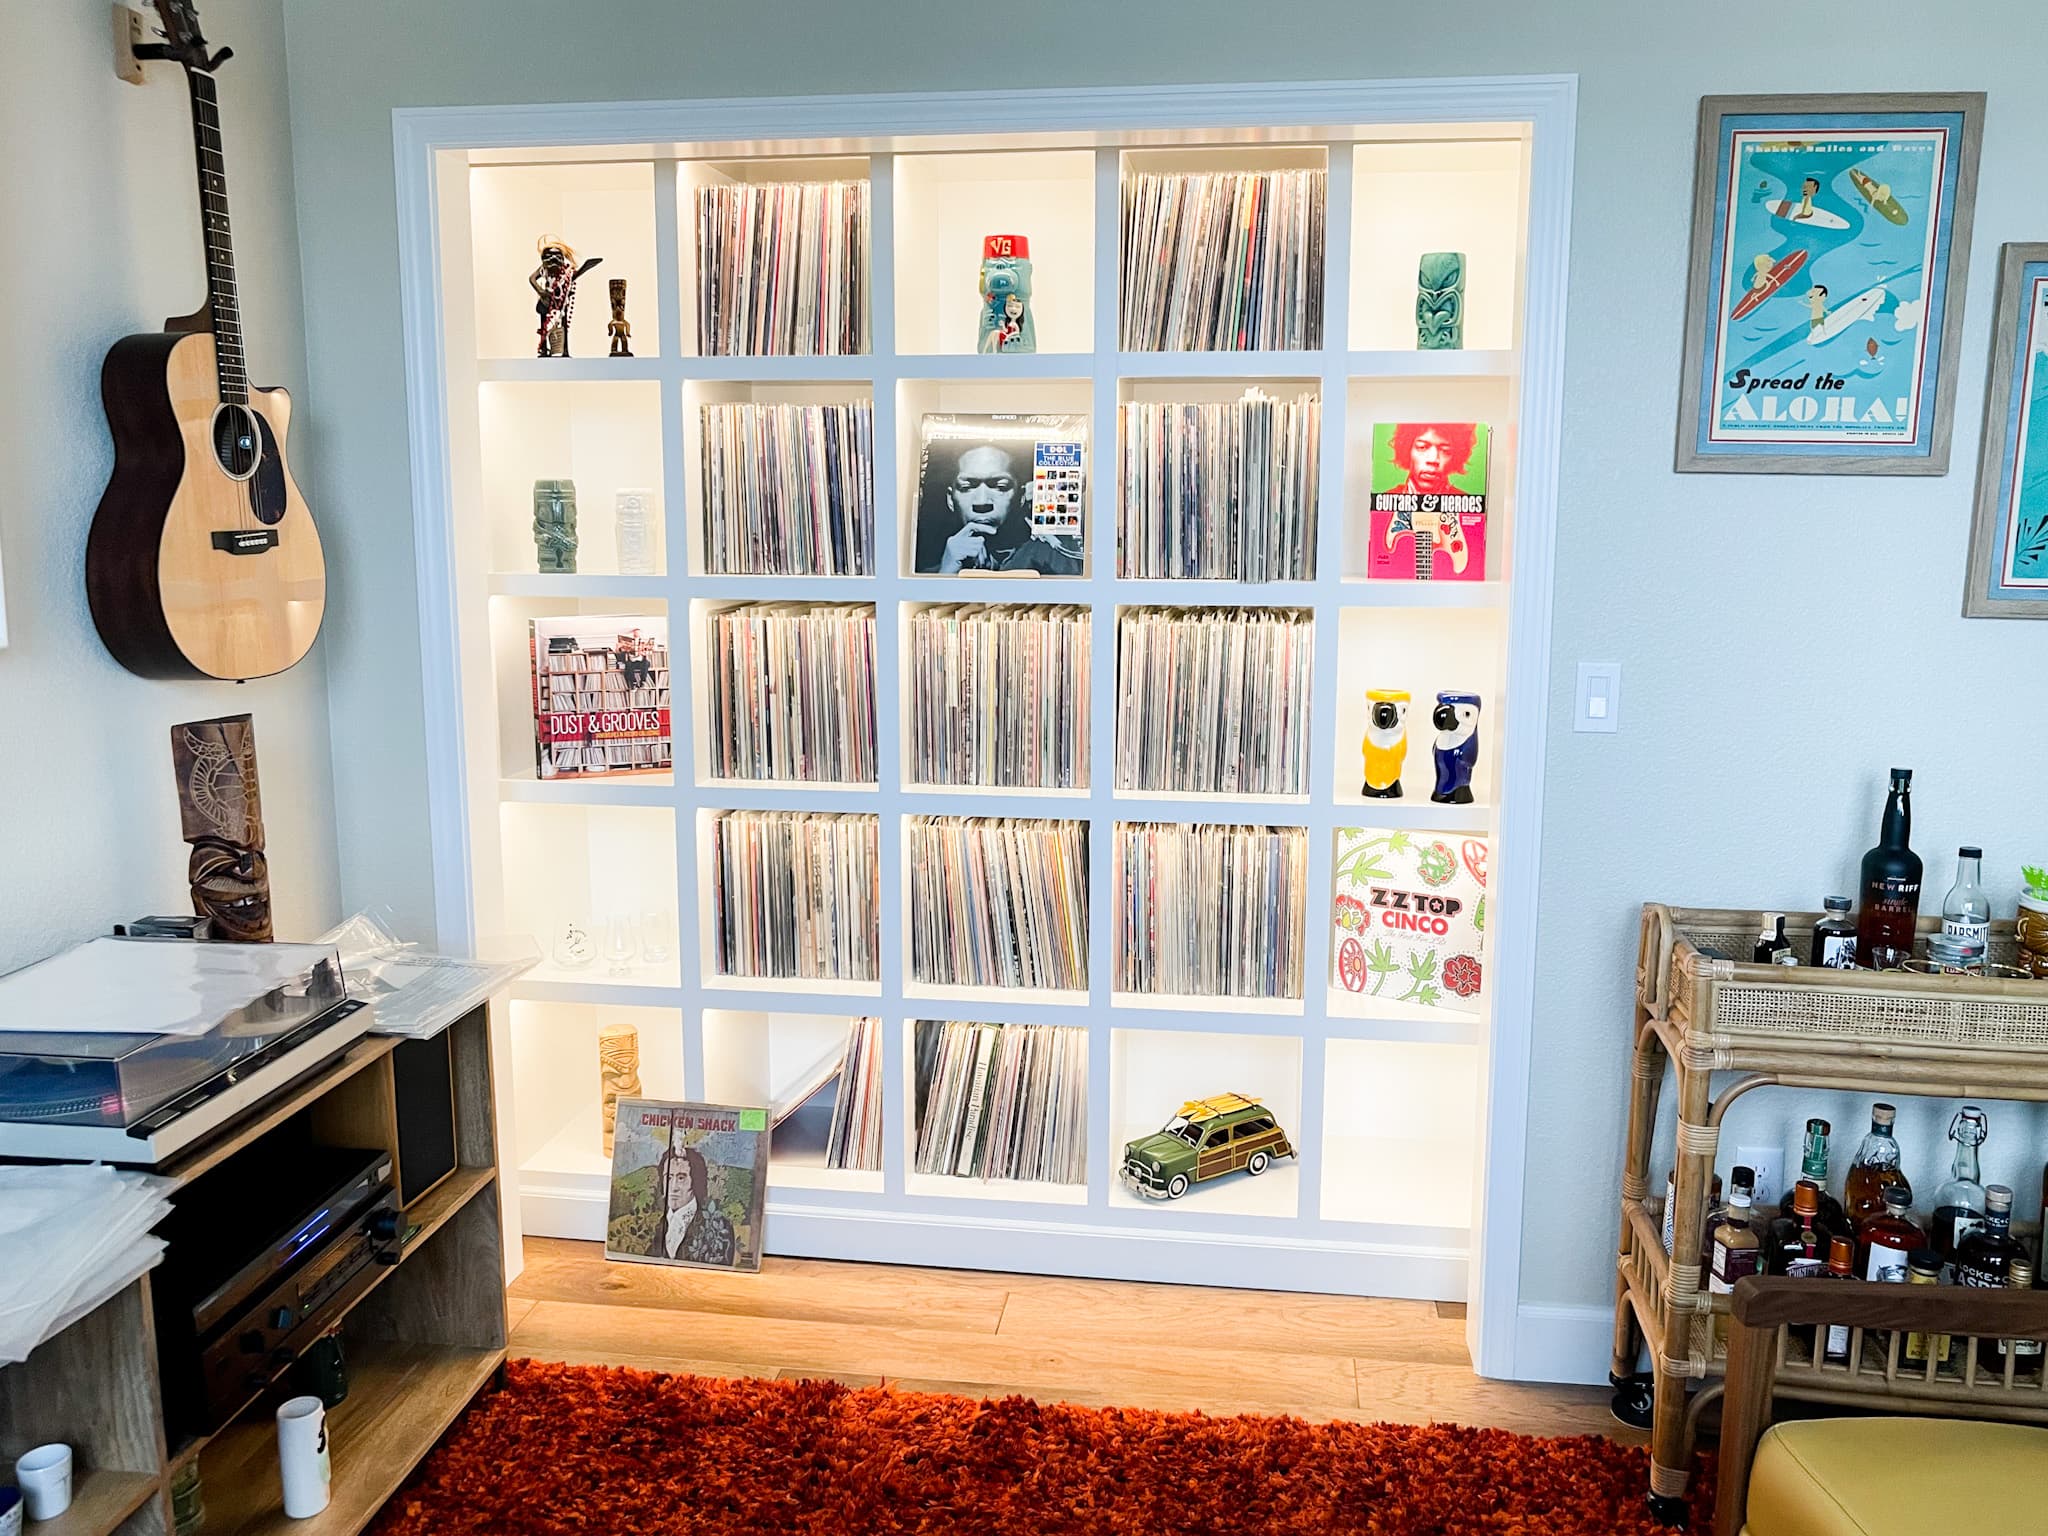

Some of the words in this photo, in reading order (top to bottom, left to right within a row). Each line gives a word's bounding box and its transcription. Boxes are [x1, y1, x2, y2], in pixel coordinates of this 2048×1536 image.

[1805, 144, 1853, 153] Smiles
[1859, 144, 1885, 153] and
[990, 237, 1012, 255] VG
[1729, 369, 1810, 394] Spread
[1814, 373, 1845, 390] the
[1723, 393, 1908, 423] ALOHA!
[1049, 446, 1068, 454] DOL
[1375, 494, 1418, 512] GUITARS
[1421, 494, 1439, 512] &
[551, 714, 584, 735] DUST
[588, 714, 600, 733] &
[602, 711, 660, 732] GROOVES
[1871, 881, 1896, 890] NEW
[1898, 884, 1919, 893] RIFF
[1412, 893, 1462, 918] TOP
[1874, 903, 1914, 913] BARREL
[1382, 911, 1449, 936] CINCO
[972, 1062, 987, 1100] Hawaiian
[641, 1113, 694, 1129] CHICKEN
[697, 1118, 736, 1133] SHACK
[965, 1103, 981, 1141] Paradise
